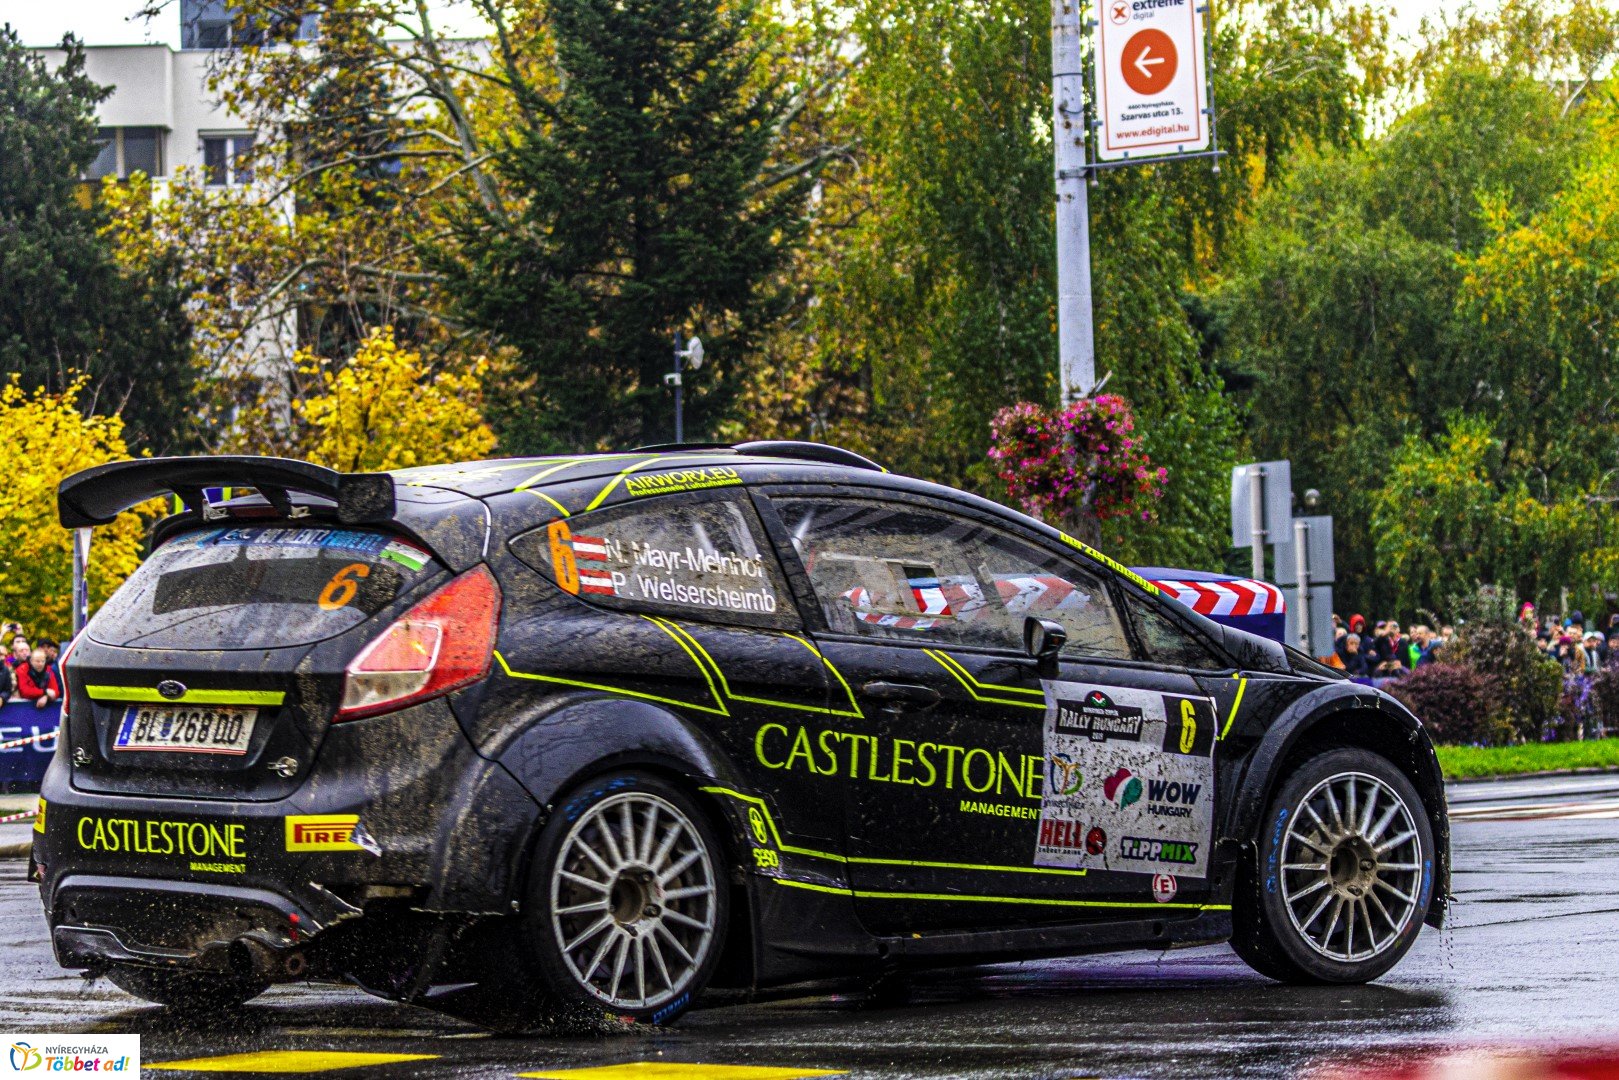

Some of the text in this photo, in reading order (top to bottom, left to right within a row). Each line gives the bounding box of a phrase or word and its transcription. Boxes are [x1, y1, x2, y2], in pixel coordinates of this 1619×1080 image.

[1132, 0, 1184, 11] extreme
[1133, 11, 1155, 21] digital
[1121, 112, 1151, 121] Szarvas
[1152, 109, 1170, 118] utca
[1116, 124, 1189, 138] www.edigital.hu
[625, 466, 738, 490] AIRWORX.EU
[547, 516, 581, 597] 6
[604, 538, 629, 563] N.
[317, 563, 370, 611] 6
[611, 571, 776, 612] P. Welsersheimb
[1058, 707, 1091, 729] RALLY
[1179, 699, 1198, 755] 6
[755, 723, 1044, 799] CASTLESTONE
[1148, 779, 1201, 805] WOW
[1147, 804, 1192, 818] HUNGARY
[77, 816, 247, 858] CASTLESTONE
[1039, 818, 1083, 849] HELL
[190, 862, 246, 873] MANAGEMENT
